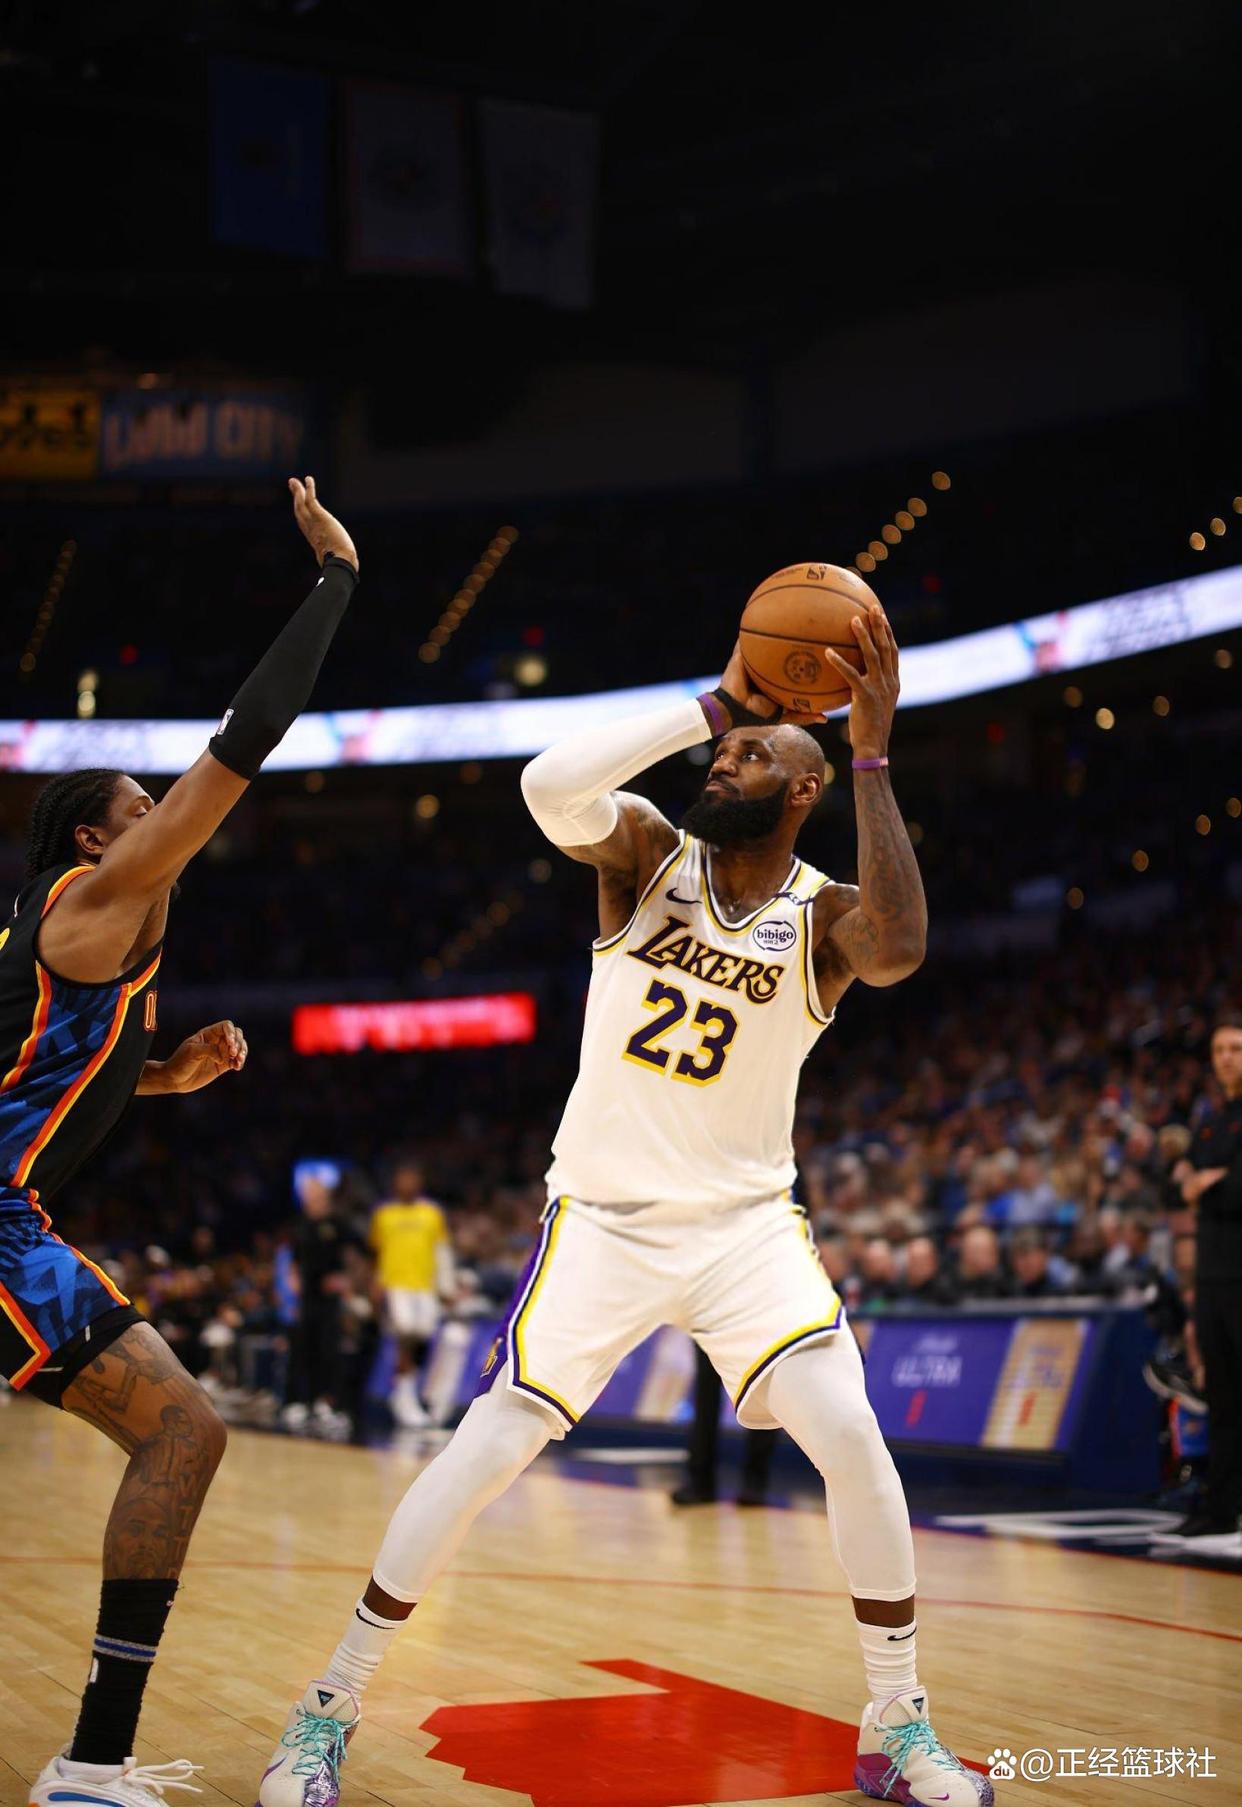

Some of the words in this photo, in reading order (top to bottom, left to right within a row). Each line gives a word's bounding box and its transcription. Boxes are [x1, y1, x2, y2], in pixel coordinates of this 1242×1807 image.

[627, 914, 786, 1004] LAKERS
[757, 929, 794, 943] bibigo
[622, 977, 740, 1088] 23
